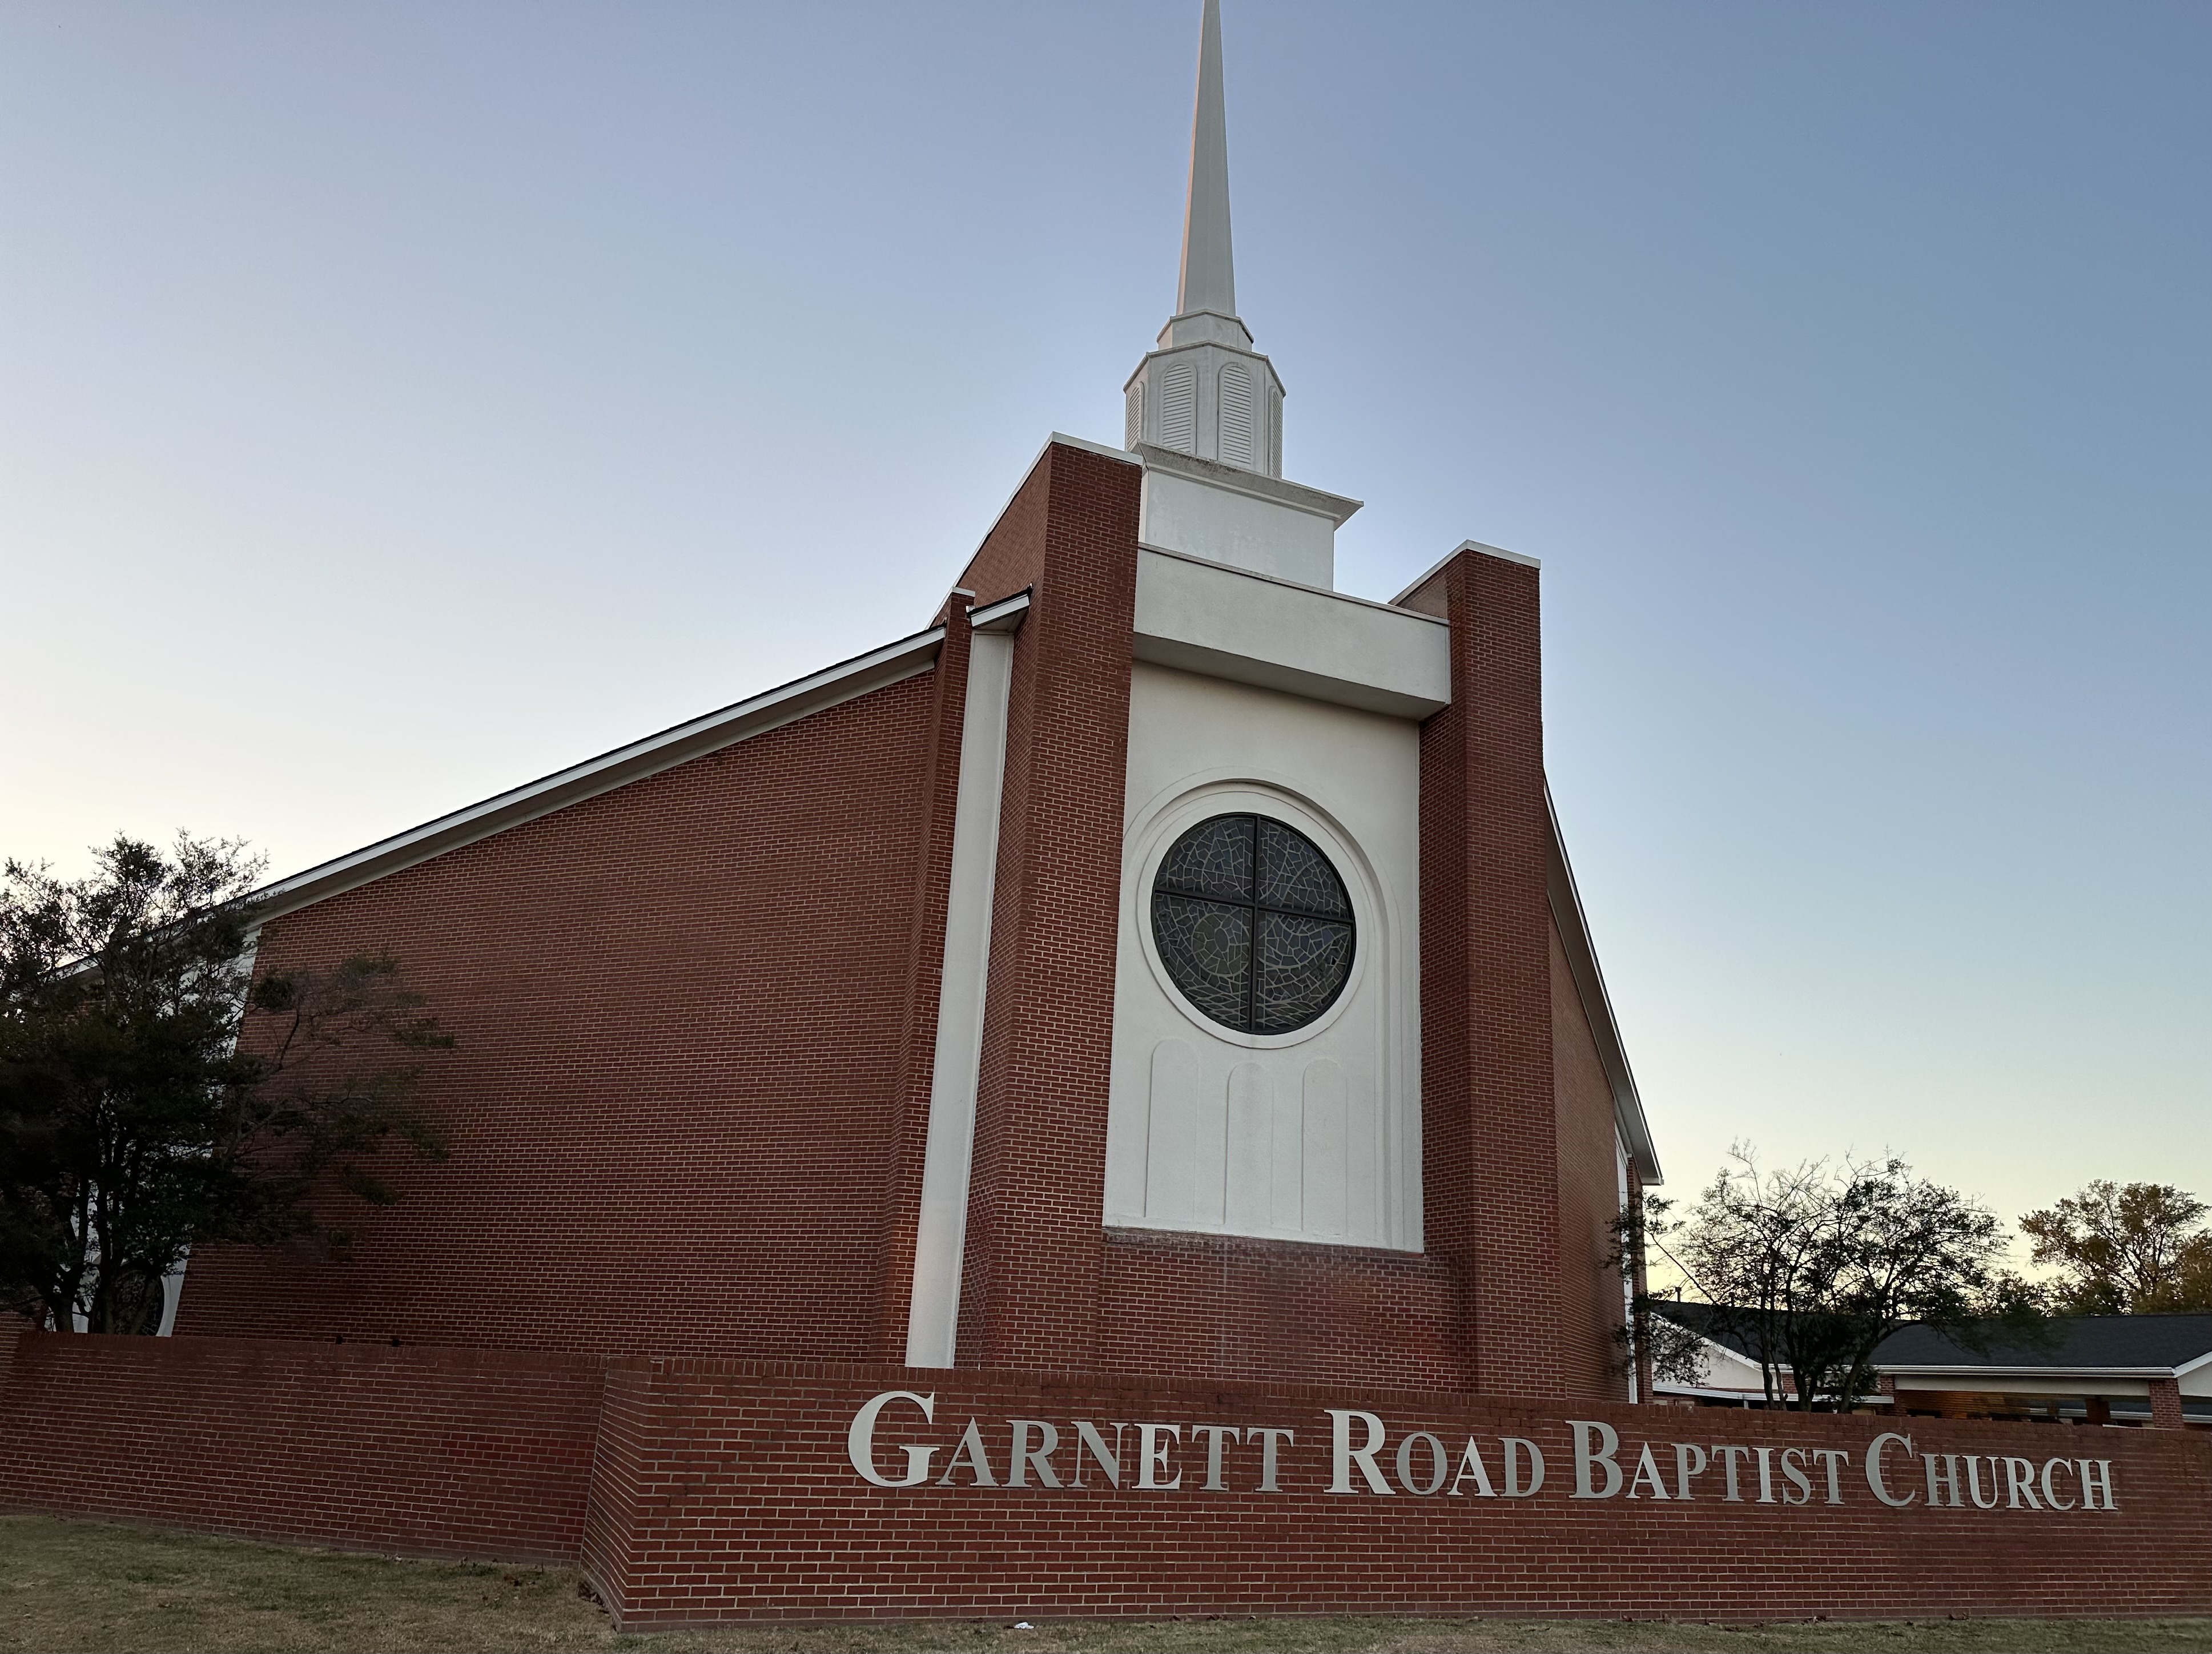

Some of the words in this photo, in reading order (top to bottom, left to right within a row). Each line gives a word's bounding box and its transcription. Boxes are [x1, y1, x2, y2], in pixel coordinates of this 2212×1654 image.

[848, 1390, 1294, 1492] GARNETT
[1324, 1409, 1545, 1498] ROAD
[1565, 1420, 1849, 1506] BAPTIST
[1865, 1432, 2118, 1510] CHURCH
